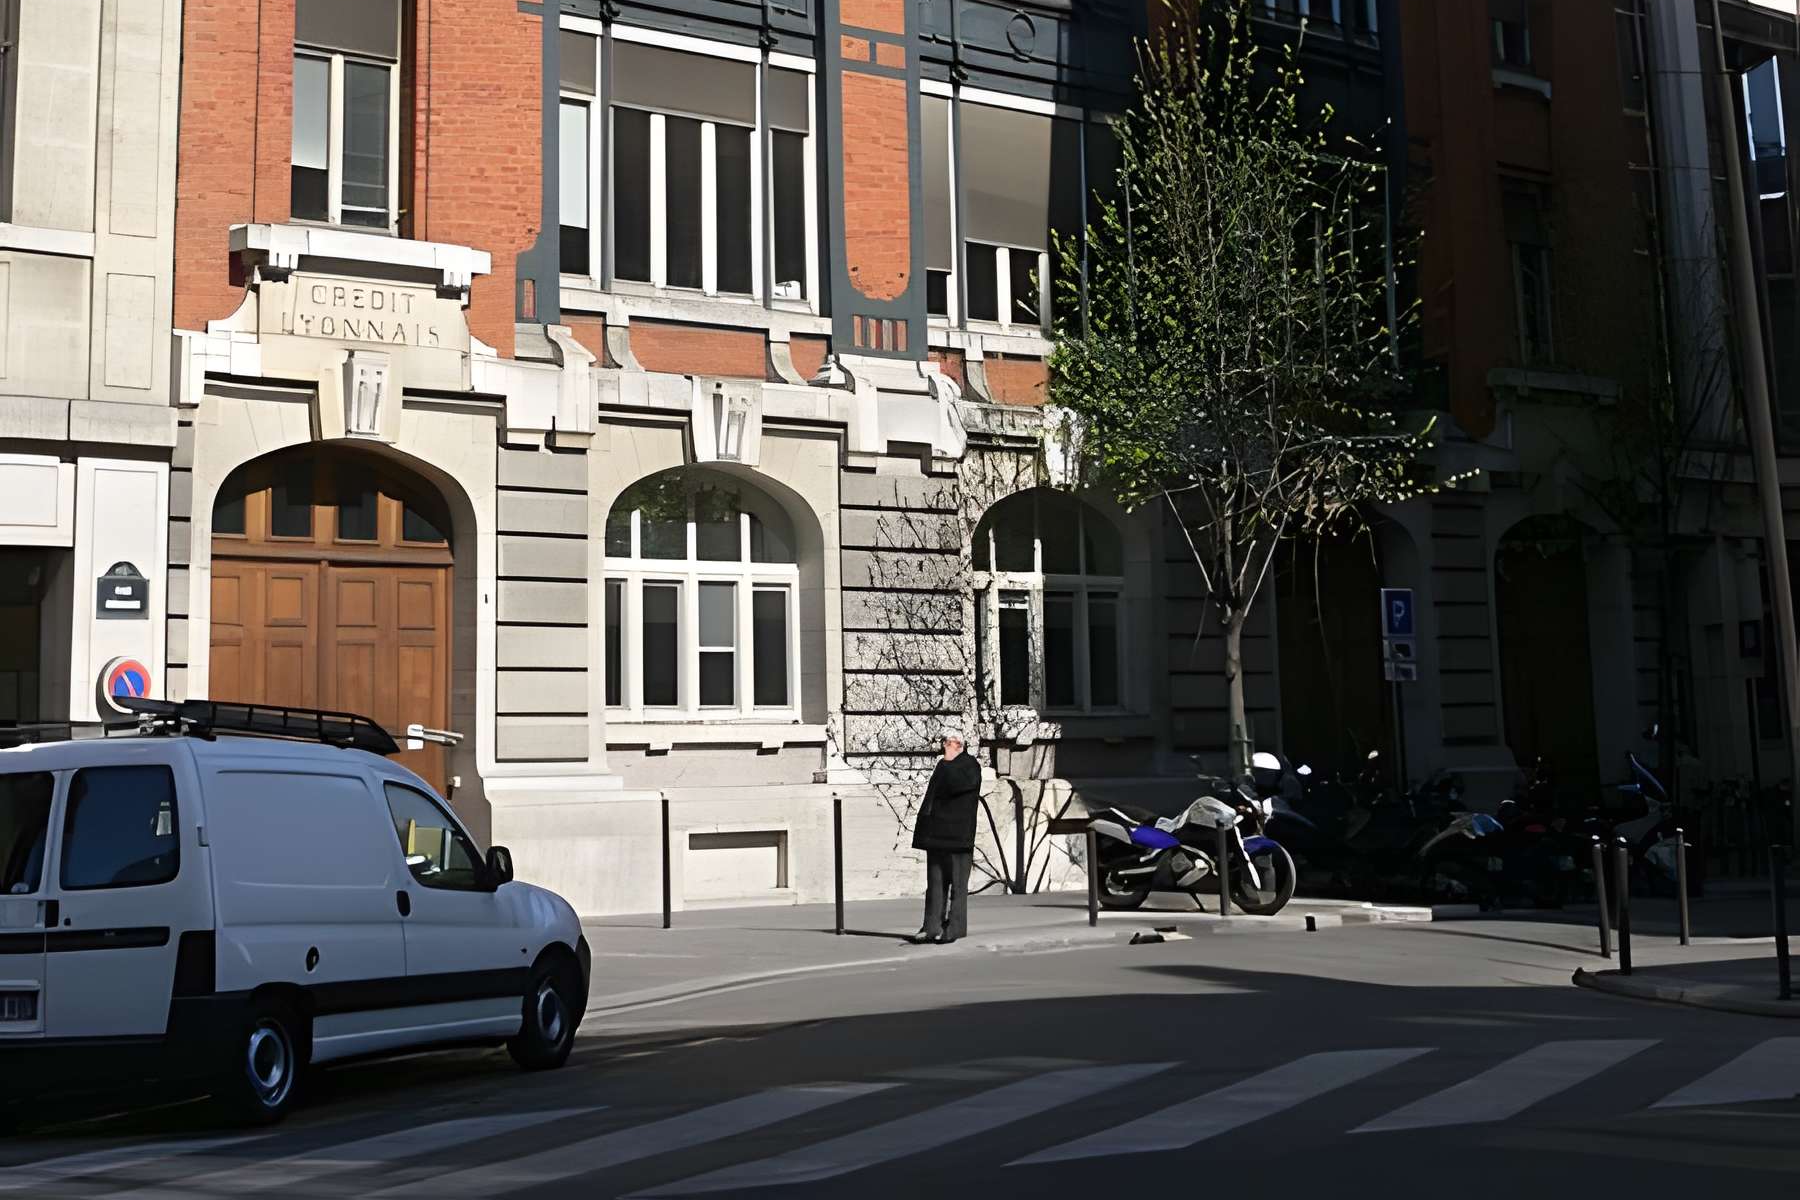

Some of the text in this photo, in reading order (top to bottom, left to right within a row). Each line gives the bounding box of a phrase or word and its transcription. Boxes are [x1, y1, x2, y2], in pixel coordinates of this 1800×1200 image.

[311, 284, 415, 314] CREDIT
[281, 311, 440, 347] LYONNAIS
[1392, 599, 1406, 628] P
